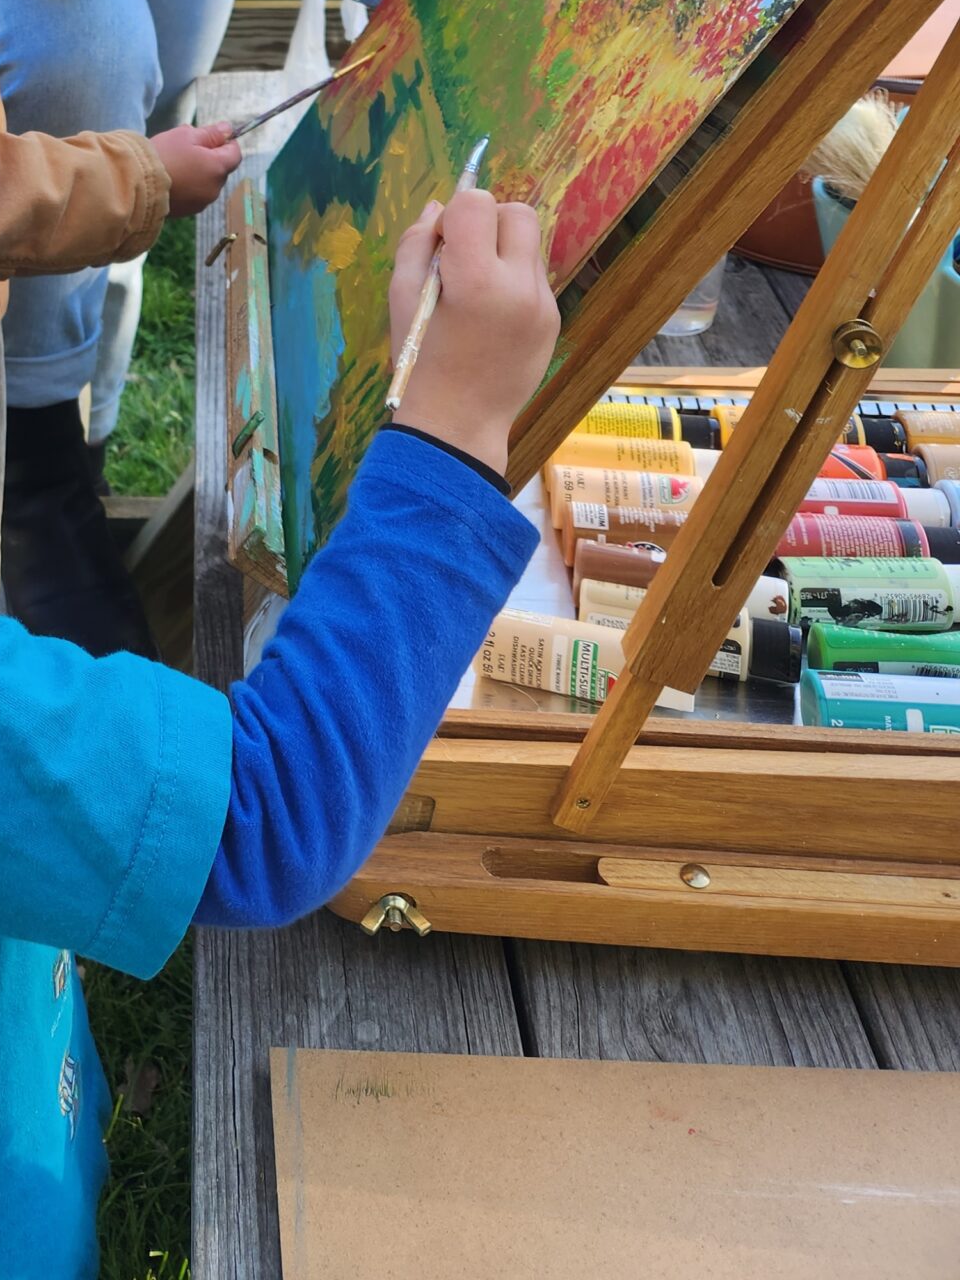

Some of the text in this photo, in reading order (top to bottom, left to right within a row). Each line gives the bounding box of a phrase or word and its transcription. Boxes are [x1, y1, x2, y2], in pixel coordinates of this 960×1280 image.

[565, 481, 573, 490] 59
[483, 650, 491, 661] oz
[511, 636, 519, 676] DISHWASHER
[831, 719, 844, 728] 2
